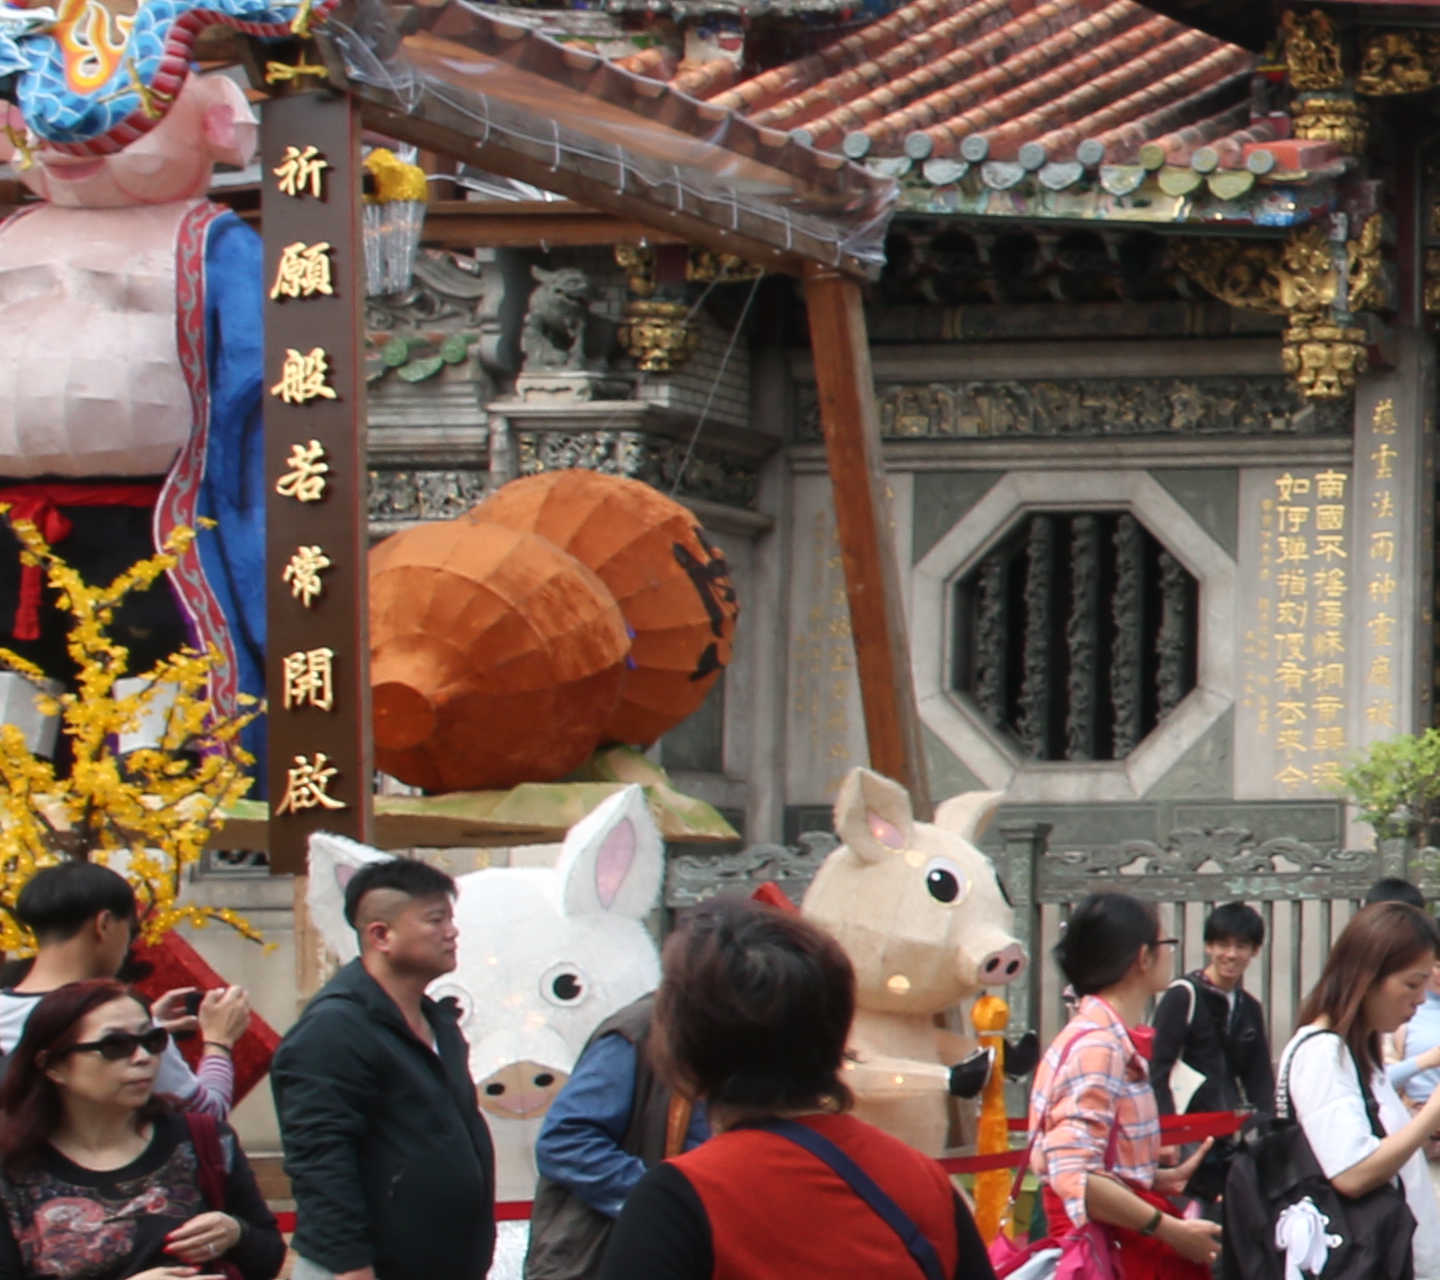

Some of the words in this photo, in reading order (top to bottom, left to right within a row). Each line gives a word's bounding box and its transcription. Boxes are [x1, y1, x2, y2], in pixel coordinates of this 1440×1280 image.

[270, 145, 346, 817] 祈願般若常開啟
